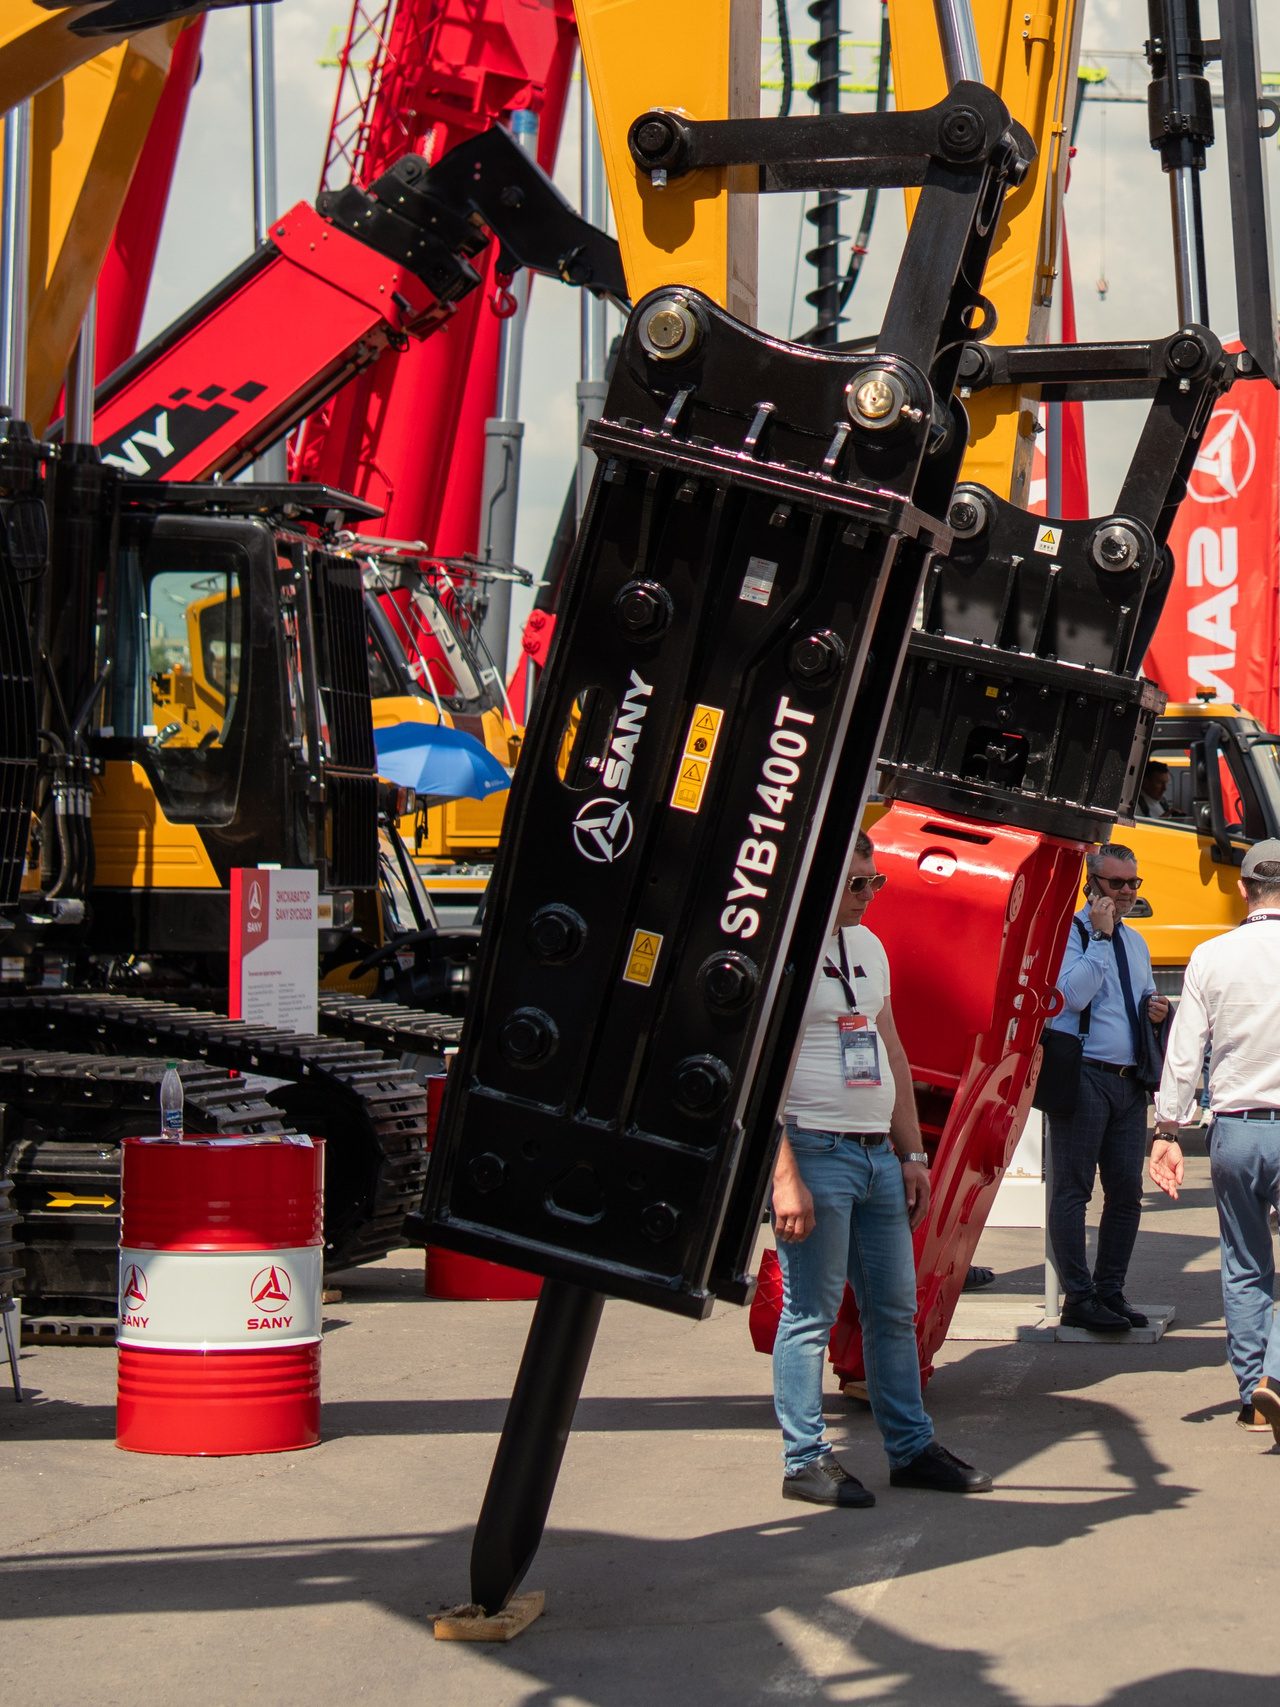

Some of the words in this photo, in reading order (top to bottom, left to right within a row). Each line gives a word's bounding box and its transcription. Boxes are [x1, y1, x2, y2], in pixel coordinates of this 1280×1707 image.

[602, 669, 654, 791] SANY
[719, 695, 816, 939] SYB1400T
[246, 921, 262, 933] SANY
[246, 1316, 294, 1330] SANY
